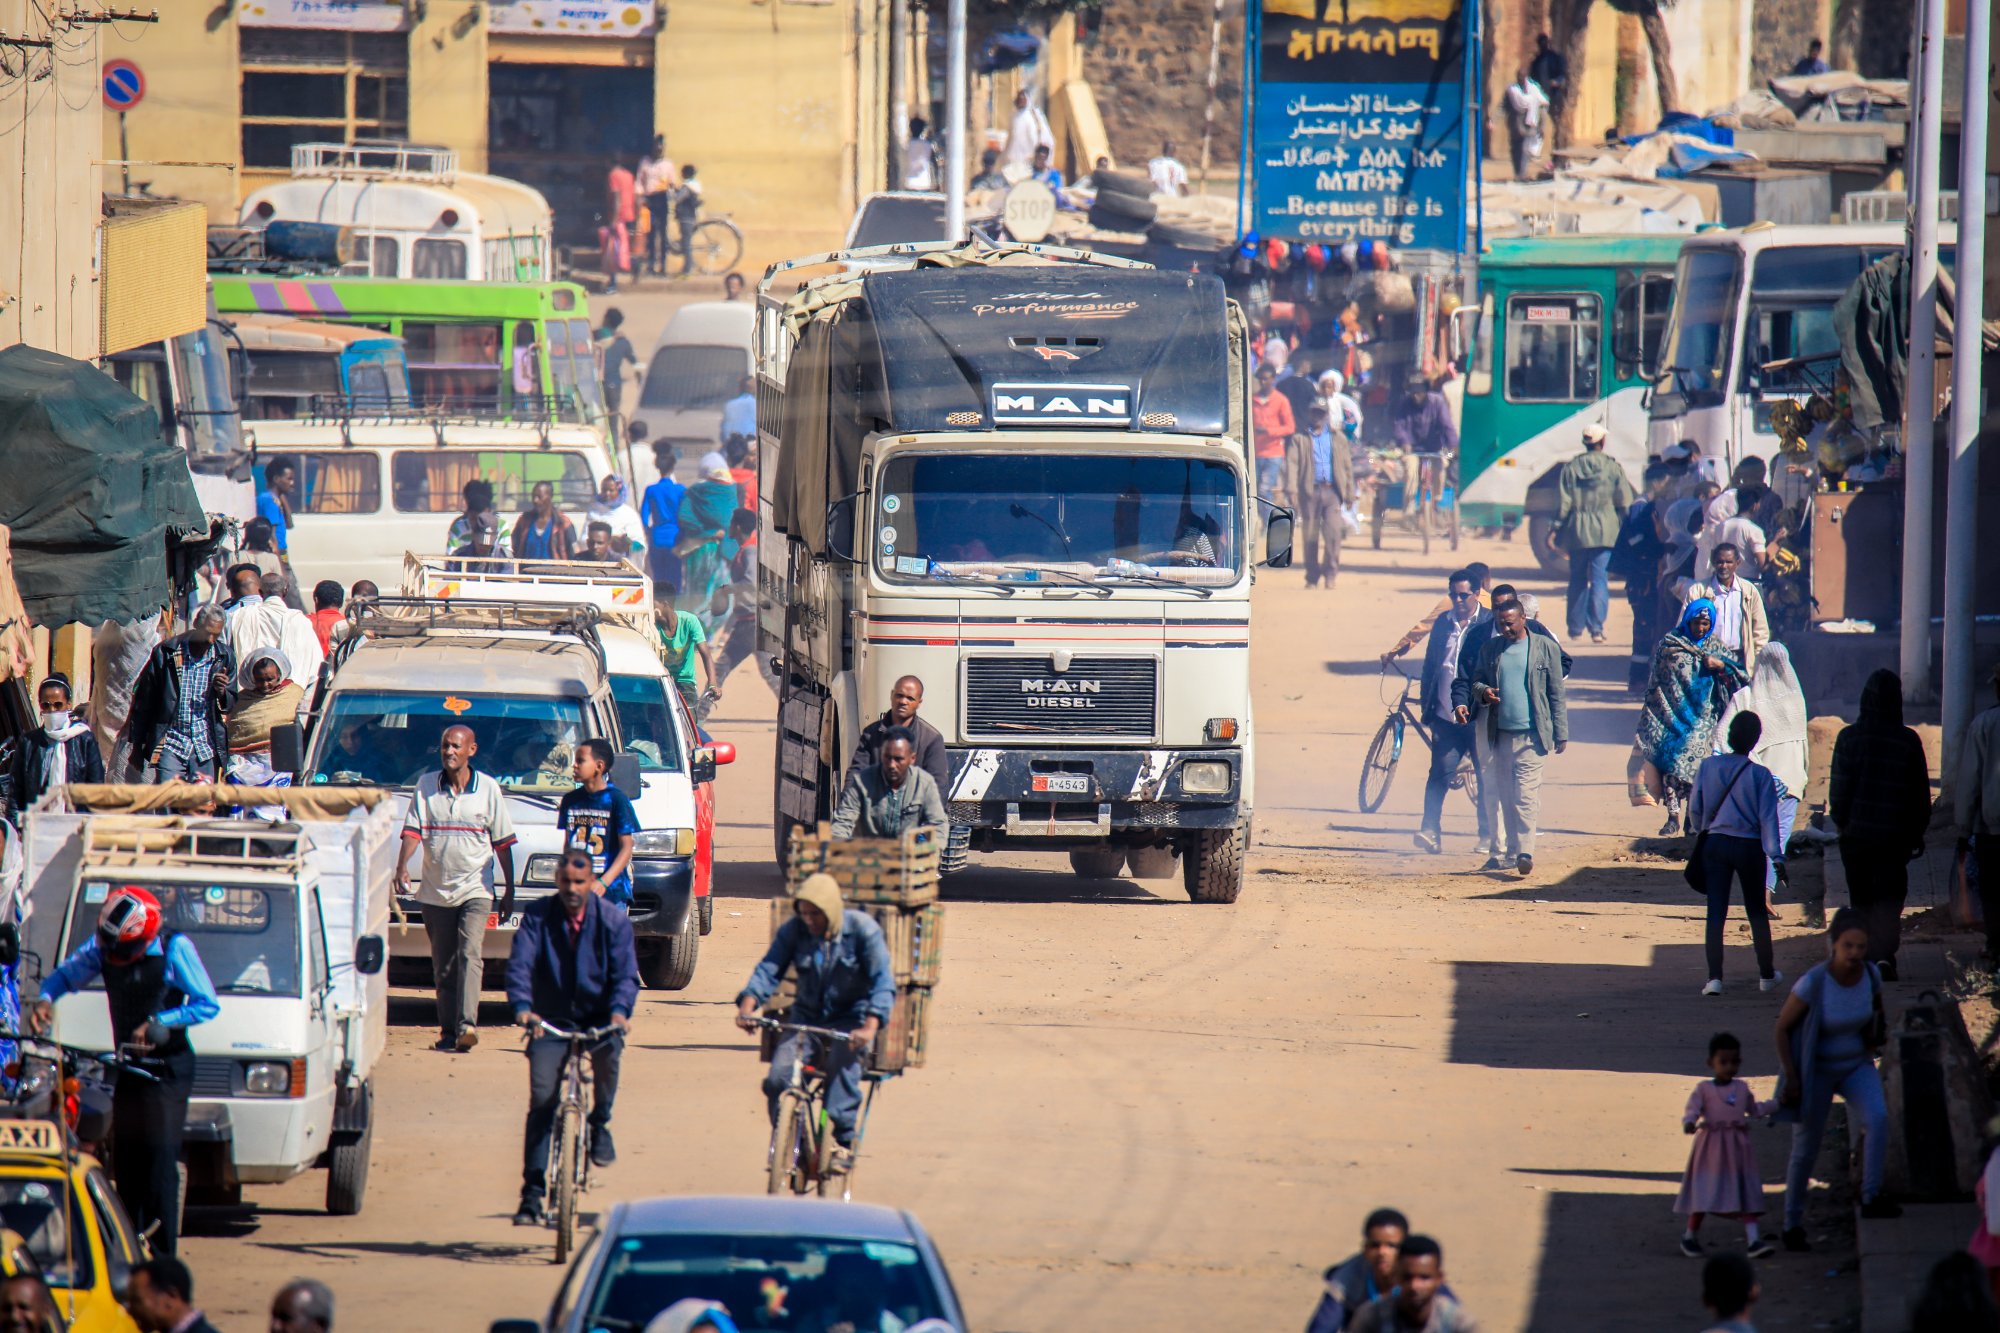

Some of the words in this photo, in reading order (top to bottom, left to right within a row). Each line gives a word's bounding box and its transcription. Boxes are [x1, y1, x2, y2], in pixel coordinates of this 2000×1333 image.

[1008, 199, 1051, 220] STOP
[1383, 195, 1419, 216] life
[1424, 196, 1444, 217] is
[1299, 217, 1416, 244] everything
[972, 301, 1140, 317] Performance
[996, 395, 1126, 414] MAN
[1027, 697, 1096, 708] DIESEL
[0, 1125, 50, 1148] AXI
